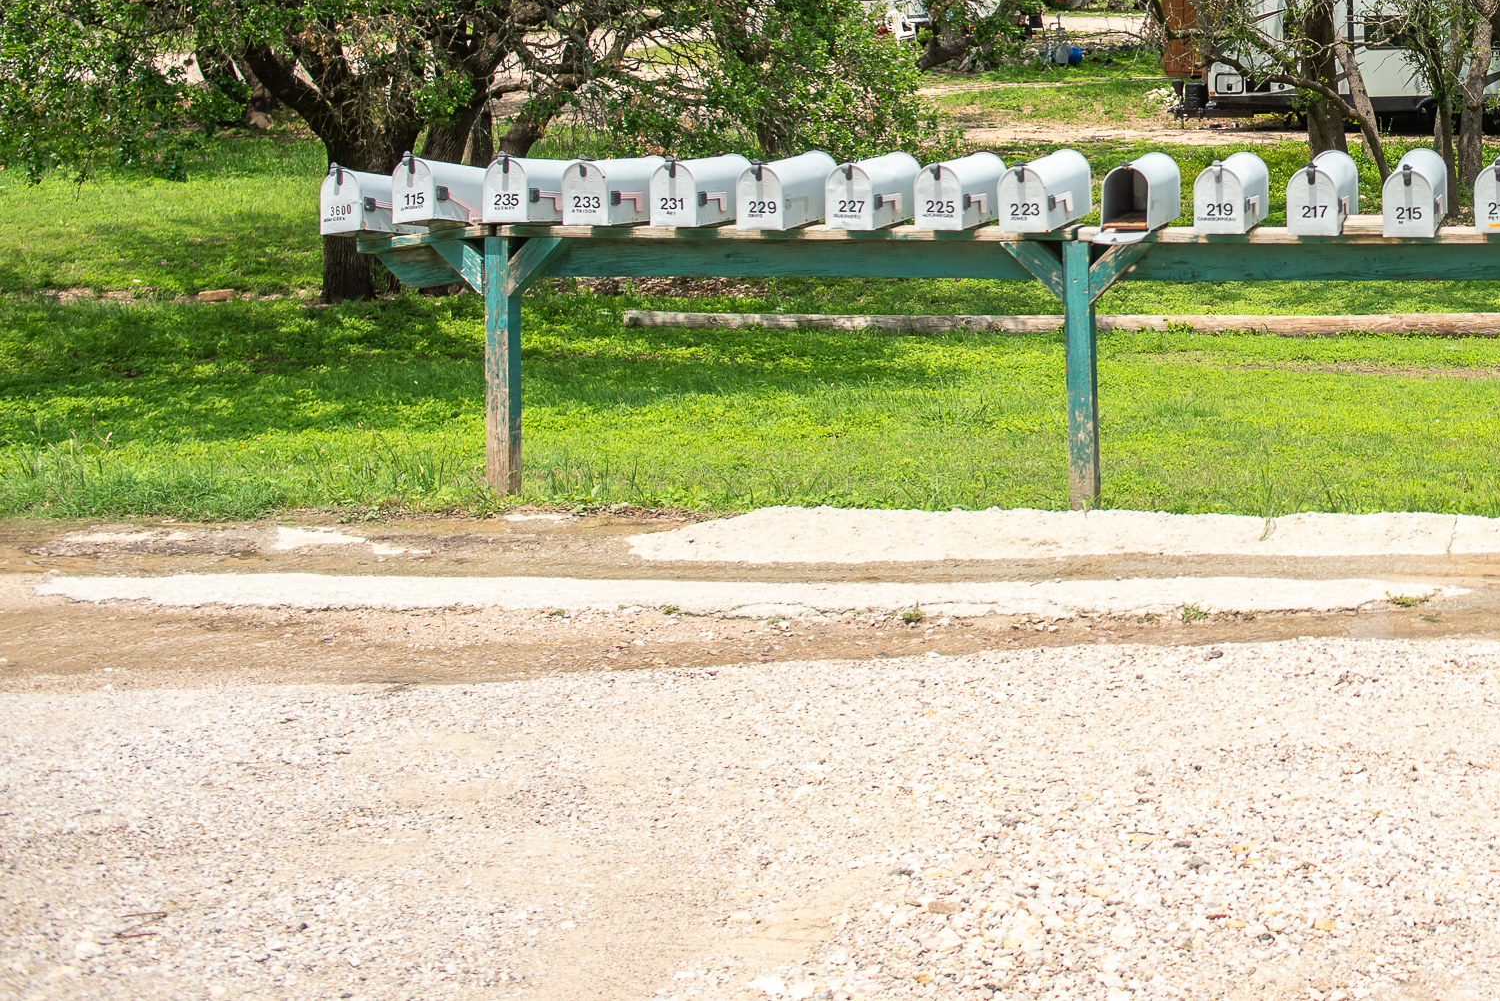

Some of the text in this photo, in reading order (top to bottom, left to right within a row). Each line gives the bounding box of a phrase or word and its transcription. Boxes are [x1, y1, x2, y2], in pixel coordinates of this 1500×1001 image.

[405, 192, 424, 205] 115
[494, 194, 518, 206] 235
[573, 196, 600, 208] 233
[660, 197, 684, 210] 231
[330, 204, 351, 216] 3600
[749, 201, 776, 214] 229
[838, 200, 865, 213] 227
[926, 200, 955, 214] 225
[1010, 203, 1039, 216] 223
[1206, 203, 1233, 216] 219
[1302, 205, 1327, 218] 217
[1395, 207, 1422, 220] 215
